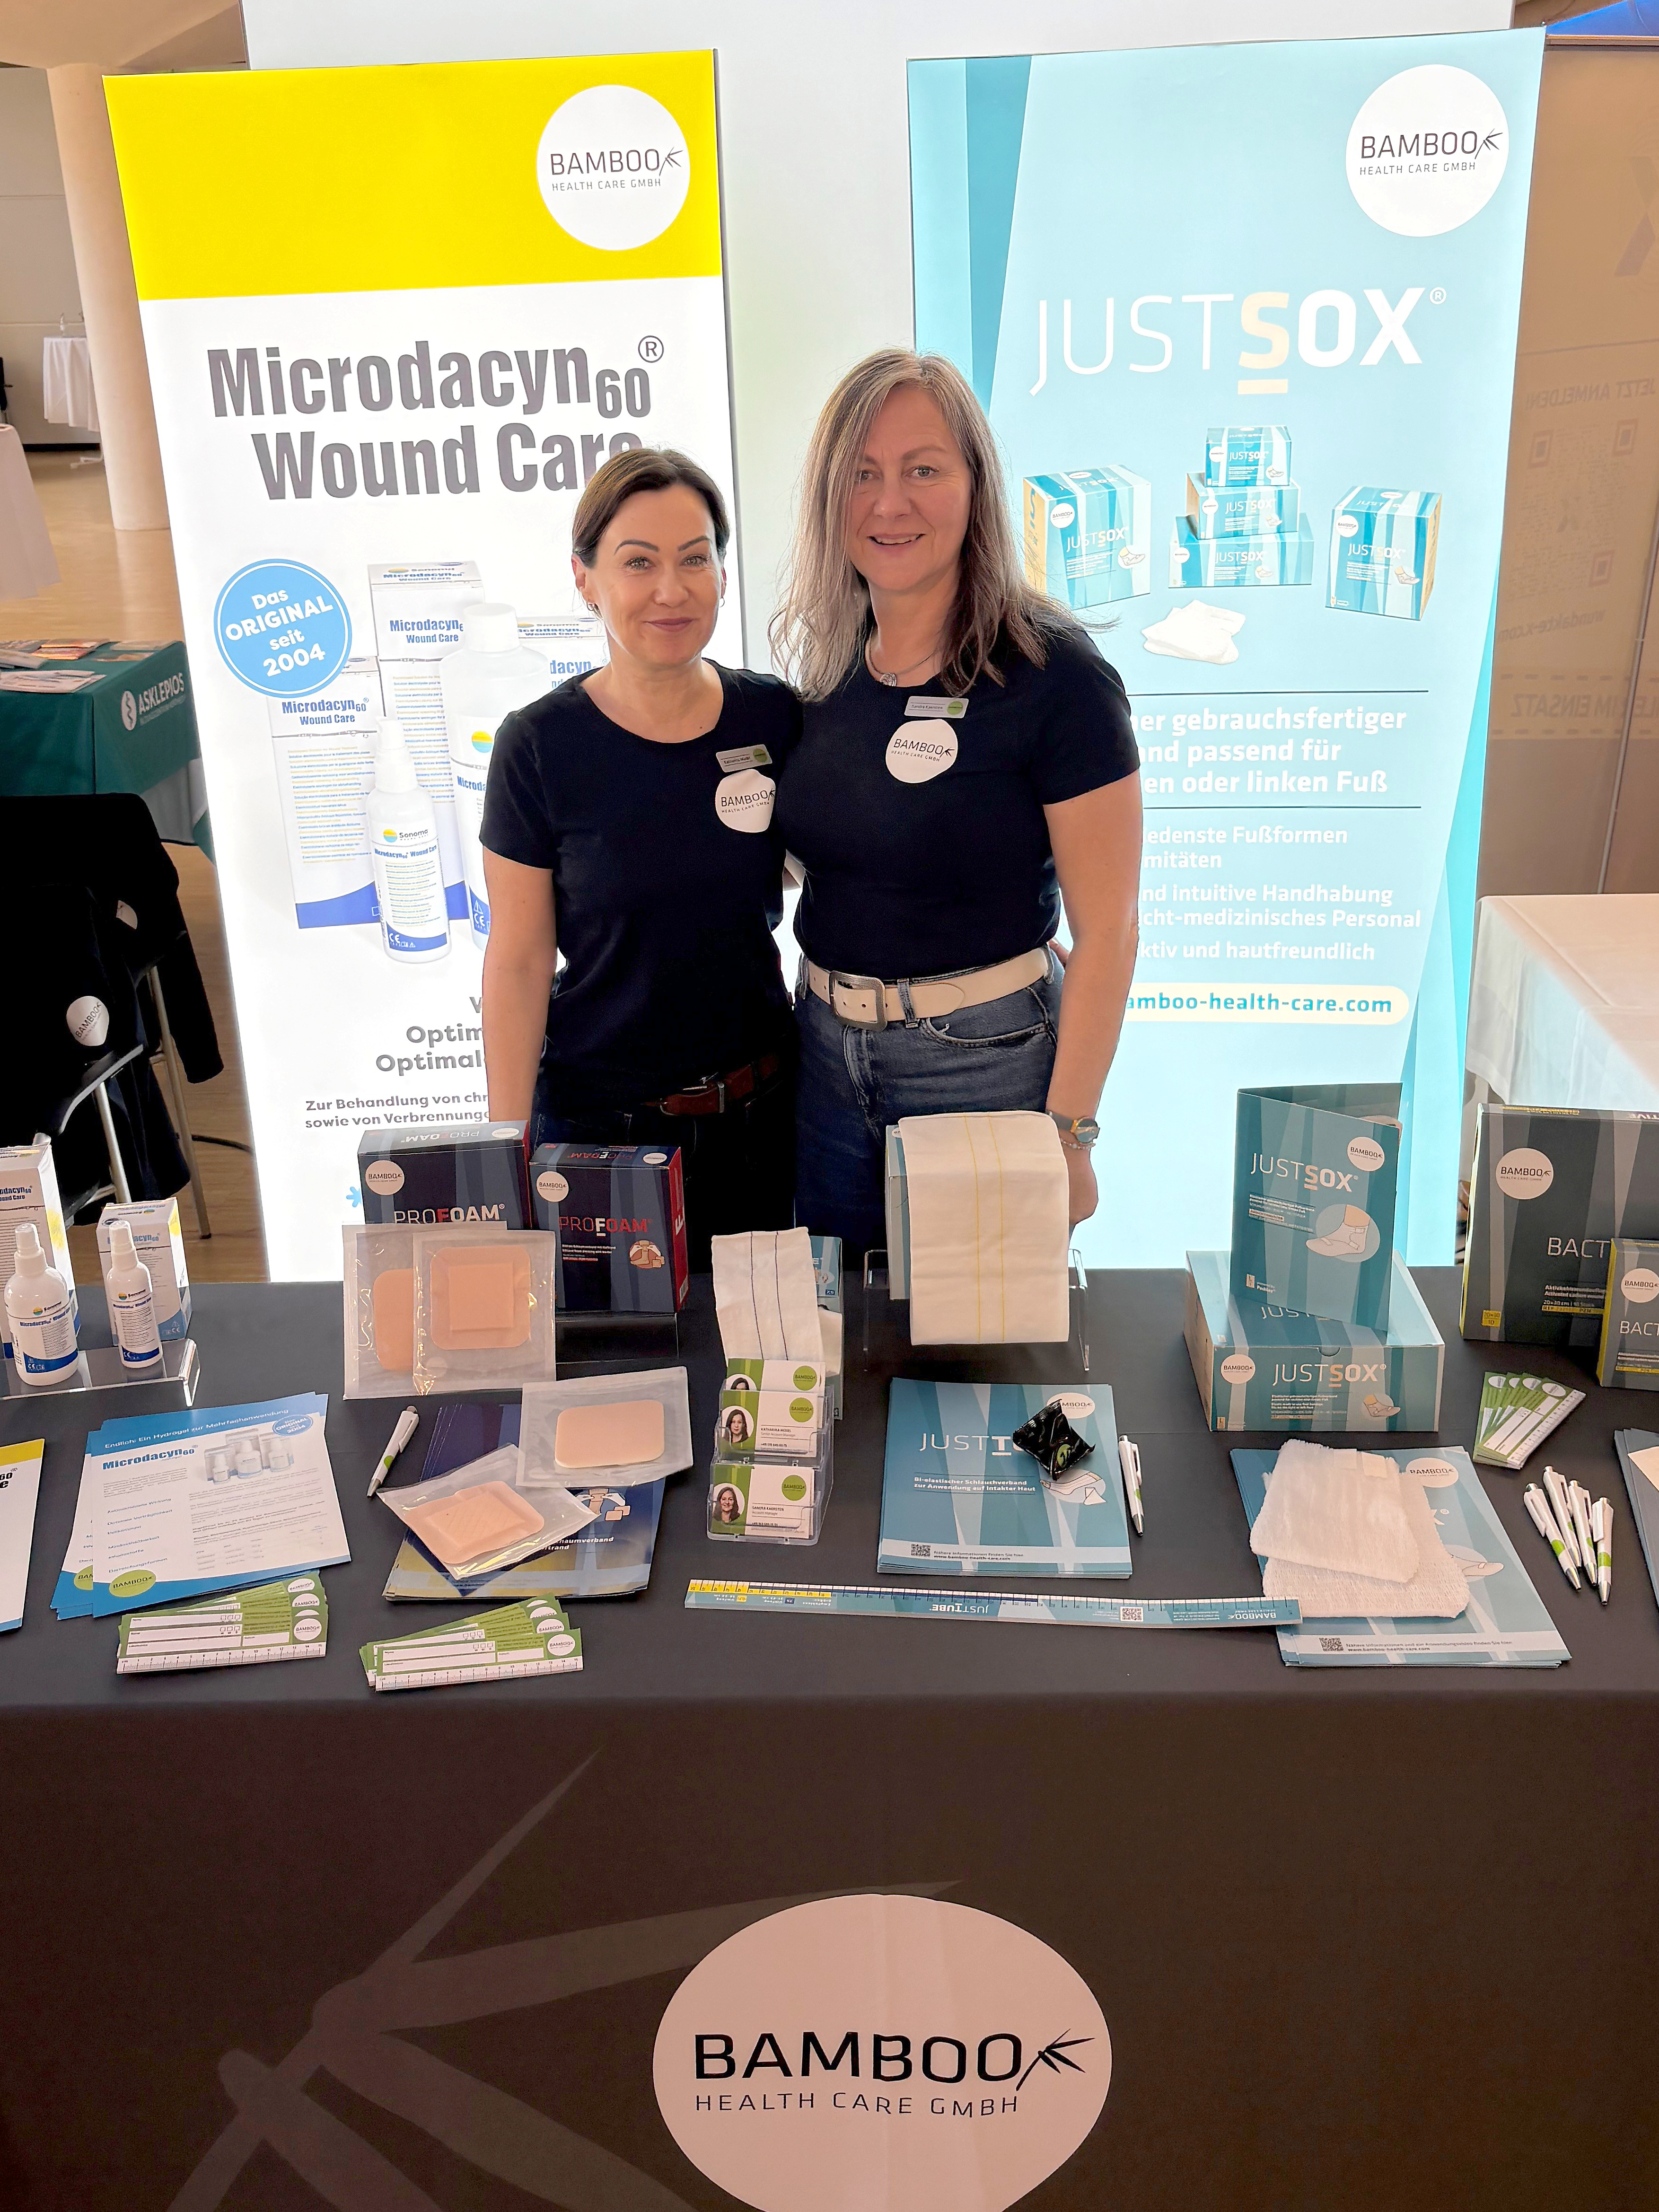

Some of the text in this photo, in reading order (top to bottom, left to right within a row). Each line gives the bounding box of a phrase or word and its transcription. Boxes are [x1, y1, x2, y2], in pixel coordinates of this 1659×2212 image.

[1361, 131, 1477, 159] BAMBOO
[551, 149, 659, 175] BAMBOO
[1360, 161, 1477, 176] HEALTH CARE GMBH
[552, 178, 661, 191] HEALTH CARE GMBH
[251, 425, 480, 500] Wound
[251, 589, 289, 610] Das
[225, 595, 334, 641] ORIGINAL
[269, 628, 305, 651] seit
[406, 634, 459, 643] Wound Care
[263, 642, 326, 677] 2004
[139, 672, 184, 715] ASKLEPIOS
[299, 714, 355, 725] Wound Care
[1172, 706, 1406, 737] gebrauchsfertiger
[894, 738, 944, 755] BAMBOO
[1187, 738, 1293, 768] passend
[1301, 738, 1342, 761] für
[1182, 771, 1240, 794] oder
[1247, 770, 1328, 793] linken
[1336, 769, 1388, 793] Fuß
[721, 790, 768, 807] BAMBOO
[1232, 825, 1348, 843] Fußformen
[1172, 885, 1257, 902] intuitive
[1263, 884, 1393, 907] Handhabung
[1332, 909, 1421, 928] Personal
[1183, 941, 1220, 959] und
[1226, 941, 1375, 960] hautfreundlich
[76, 1006, 99, 1037] BAMBOO
[306, 1100, 333, 1111] Zur
[336, 1096, 429, 1109] Behandlung
[432, 1094, 460, 1104] von
[306, 1116, 349, 1128] sowie
[352, 1115, 381, 1125] von
[1350, 1146, 1378, 1159] BAMBOO
[1501, 1166, 1543, 1177] BAMBOO
[276, 1417, 308, 1431] ORIGINAL
[287, 1425, 306, 1434] 2004
[105, 1439, 136, 1448] Endlich:
[154, 1428, 189, 1439] Hydrogel
[113, 1577, 148, 1589] BAMBOO
[694, 2031, 1022, 2083] BAMBOO
[696, 2092, 1017, 2118] HEALTH CARE GMBH
